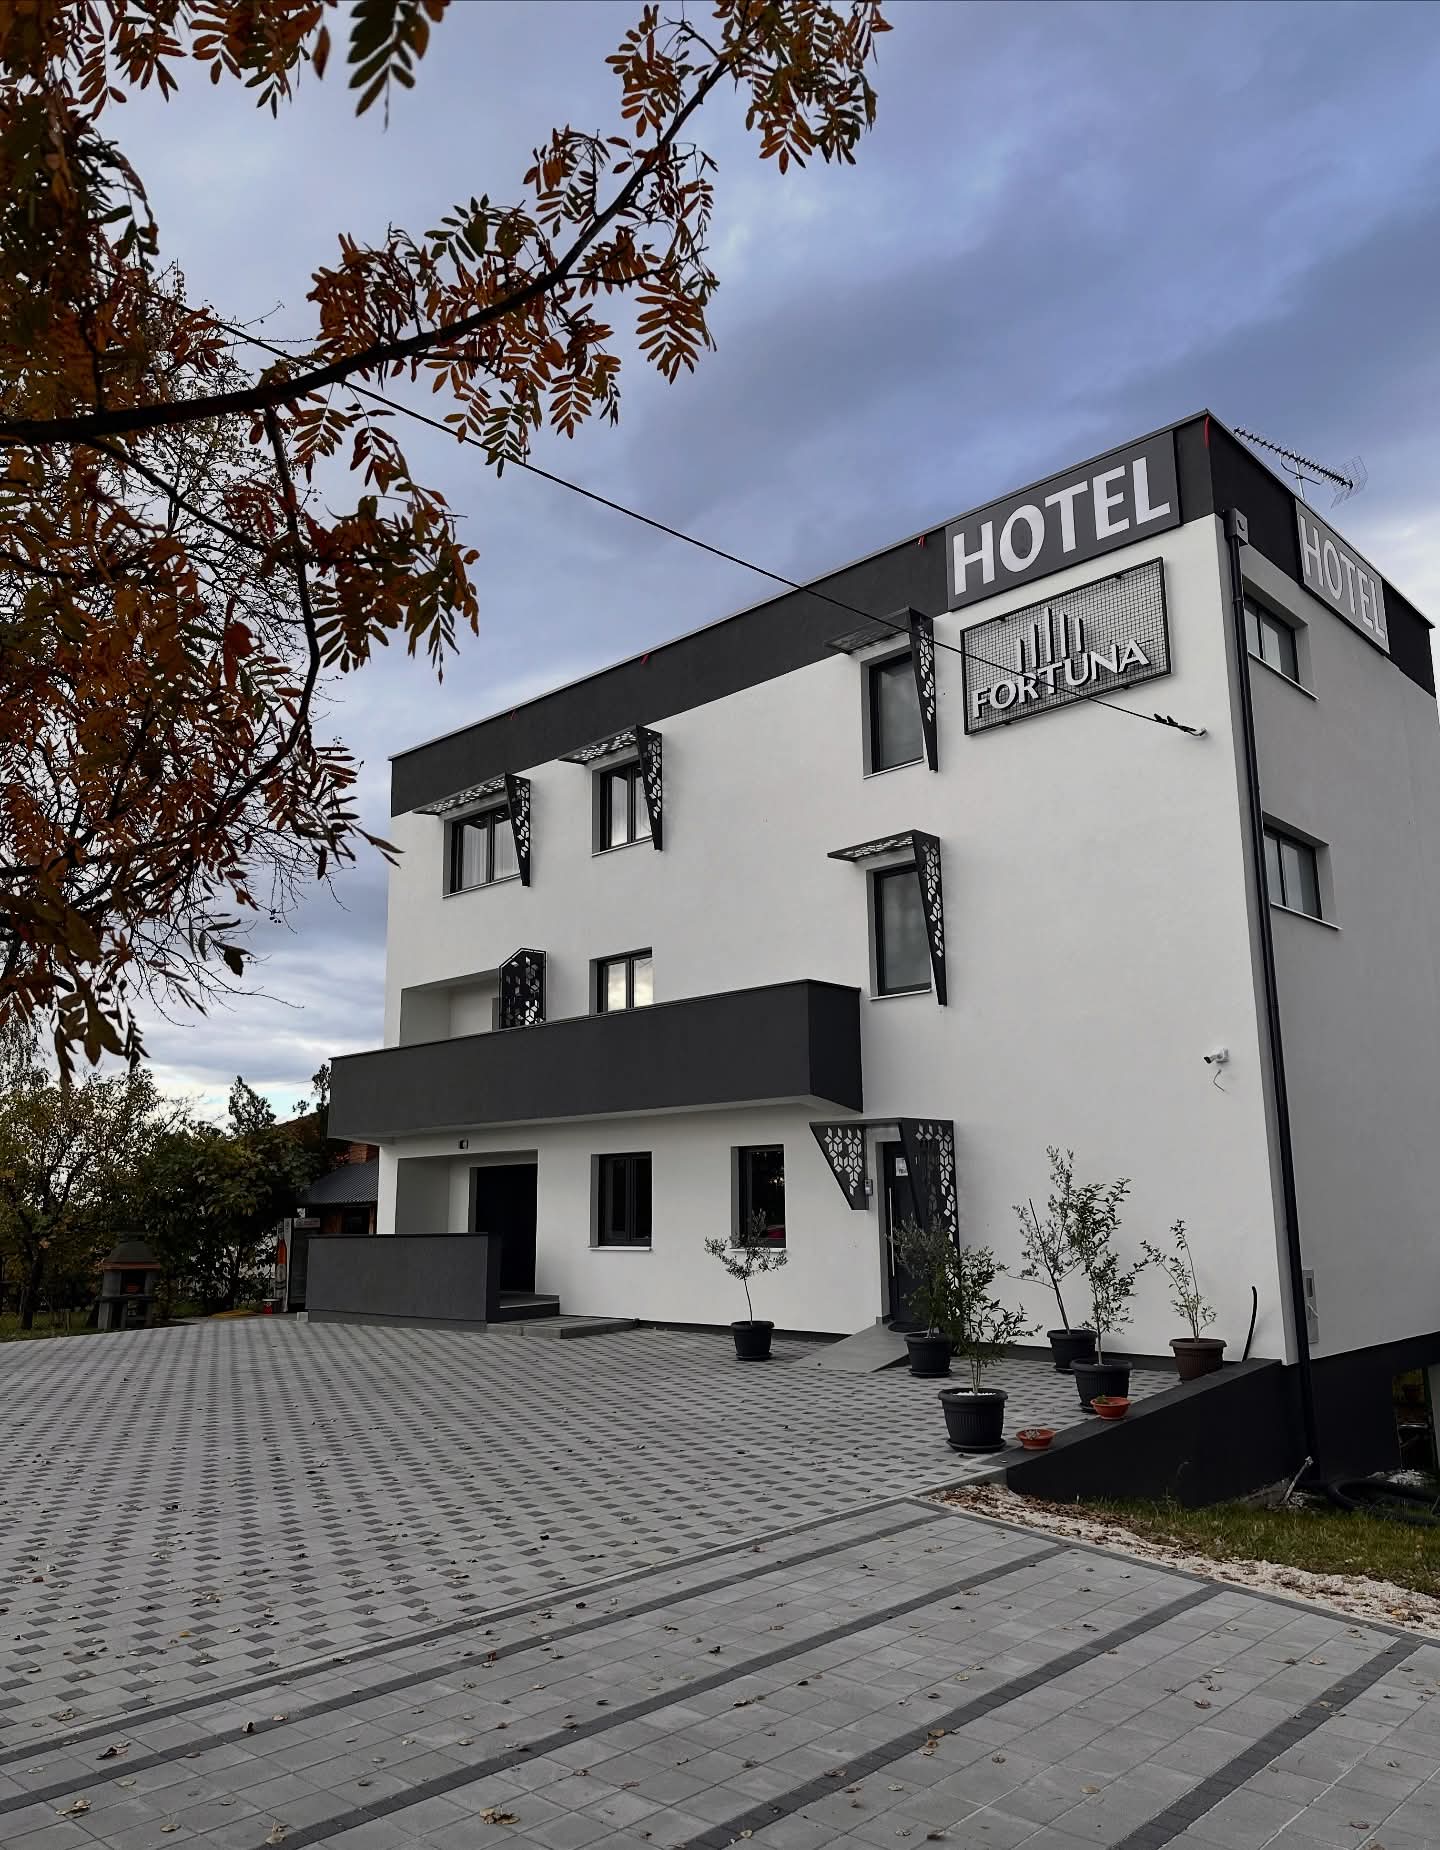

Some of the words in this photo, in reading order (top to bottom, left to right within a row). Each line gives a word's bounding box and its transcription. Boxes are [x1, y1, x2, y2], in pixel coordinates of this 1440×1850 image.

[953, 457, 1170, 595] HOTEL
[1299, 514, 1385, 640] HOTEL
[972, 639, 1150, 718] FORTUNA
